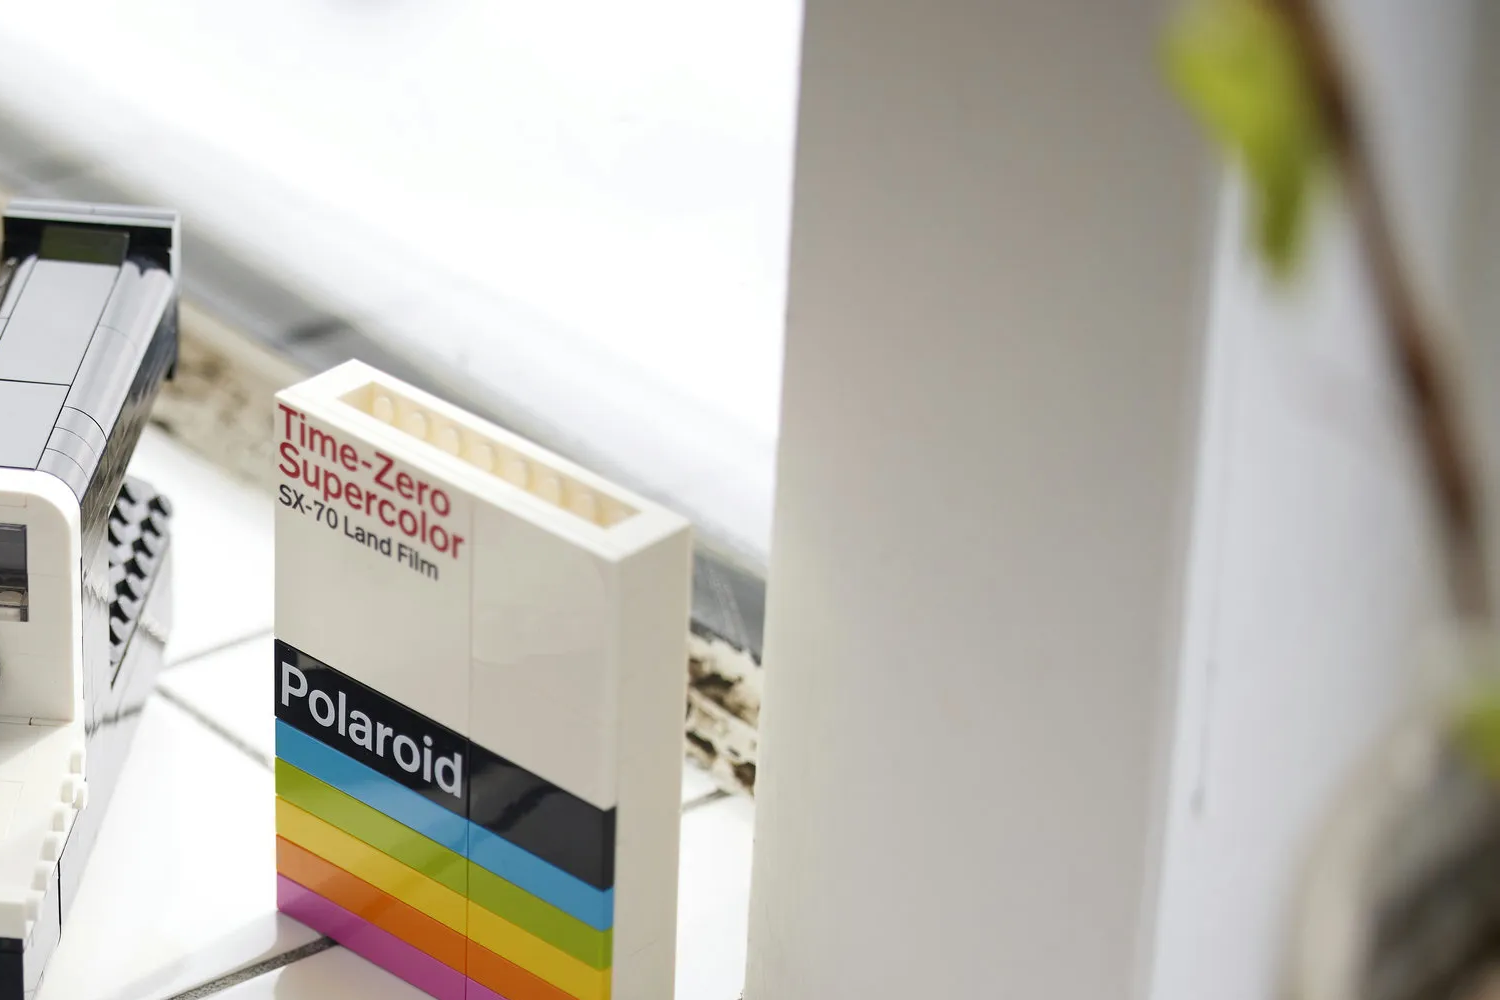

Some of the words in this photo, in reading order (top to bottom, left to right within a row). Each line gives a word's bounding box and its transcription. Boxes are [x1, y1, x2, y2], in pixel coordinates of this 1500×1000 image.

[278, 403, 451, 517] Time-Zero
[278, 441, 465, 559] Supercolor
[278, 483, 338, 530] SX-70
[343, 515, 392, 557] Land
[397, 543, 439, 580] Film
[281, 661, 463, 799] Polaroid
